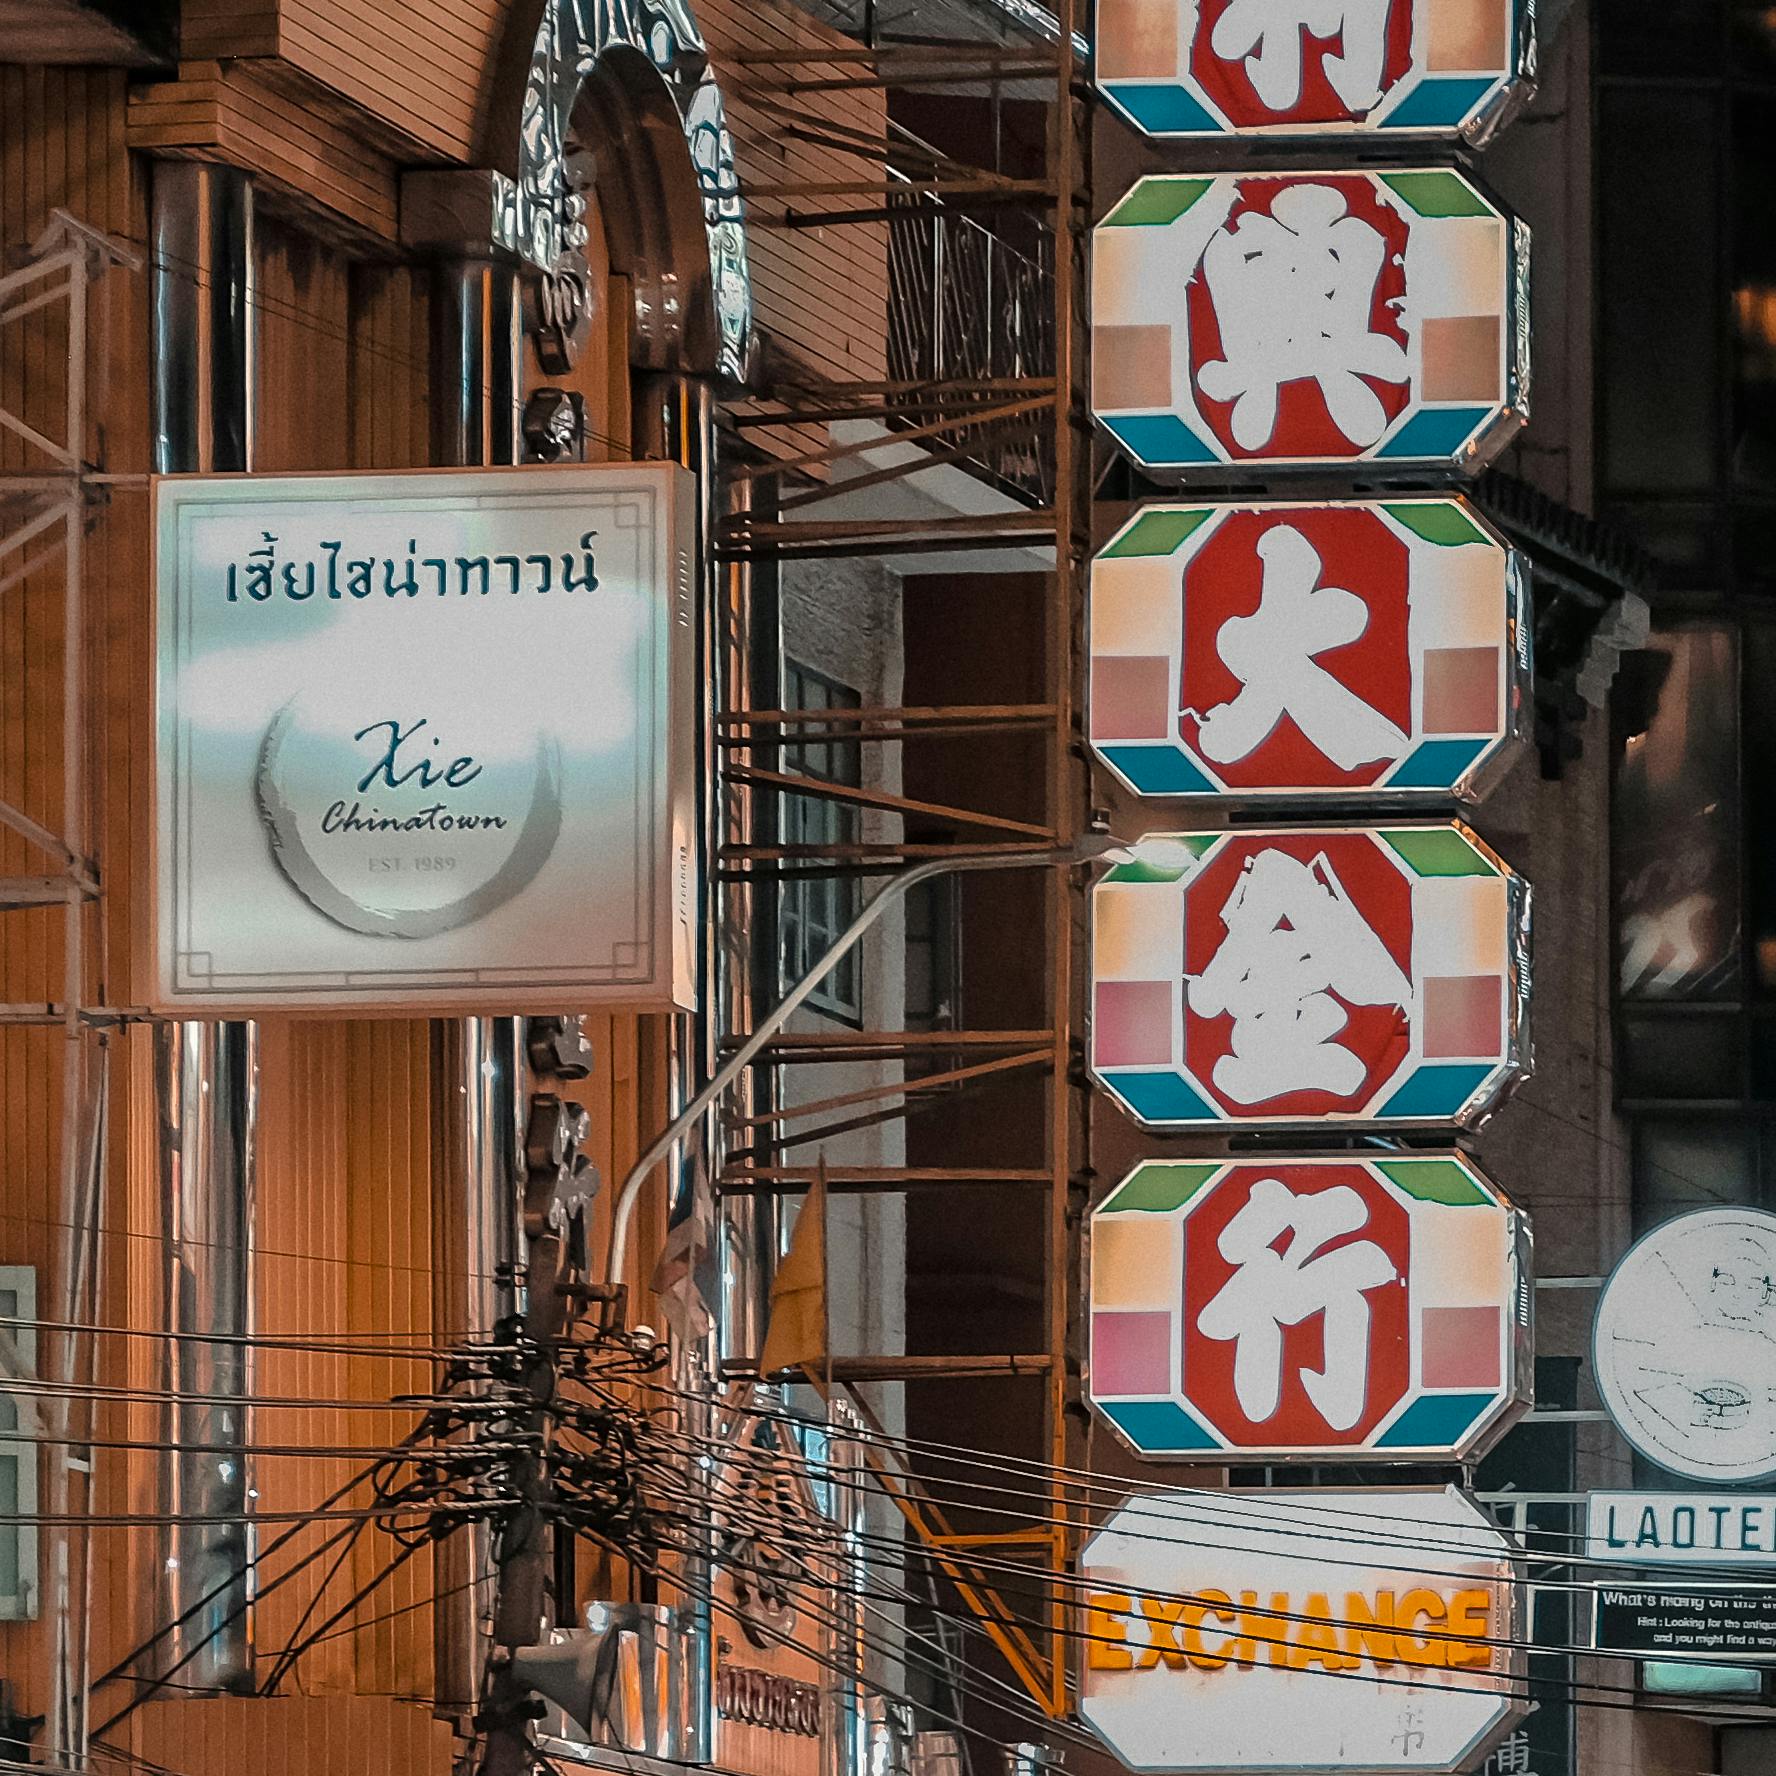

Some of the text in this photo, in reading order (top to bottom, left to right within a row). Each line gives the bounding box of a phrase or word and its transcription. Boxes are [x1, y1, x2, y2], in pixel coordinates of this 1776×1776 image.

[354, 718, 483, 793] Xie
[321, 800, 508, 834] Chinatown
[1089, 1588, 1491, 1671] EXCHANGE
[1665, 1616, 1705, 1630] Looking
[1707, 1618, 1721, 1628] for
[1675, 1634, 1693, 1646] you
[1696, 1633, 1723, 1646] might
[1727, 1633, 1746, 1645] find
[1757, 1636, 1776, 1648] way
